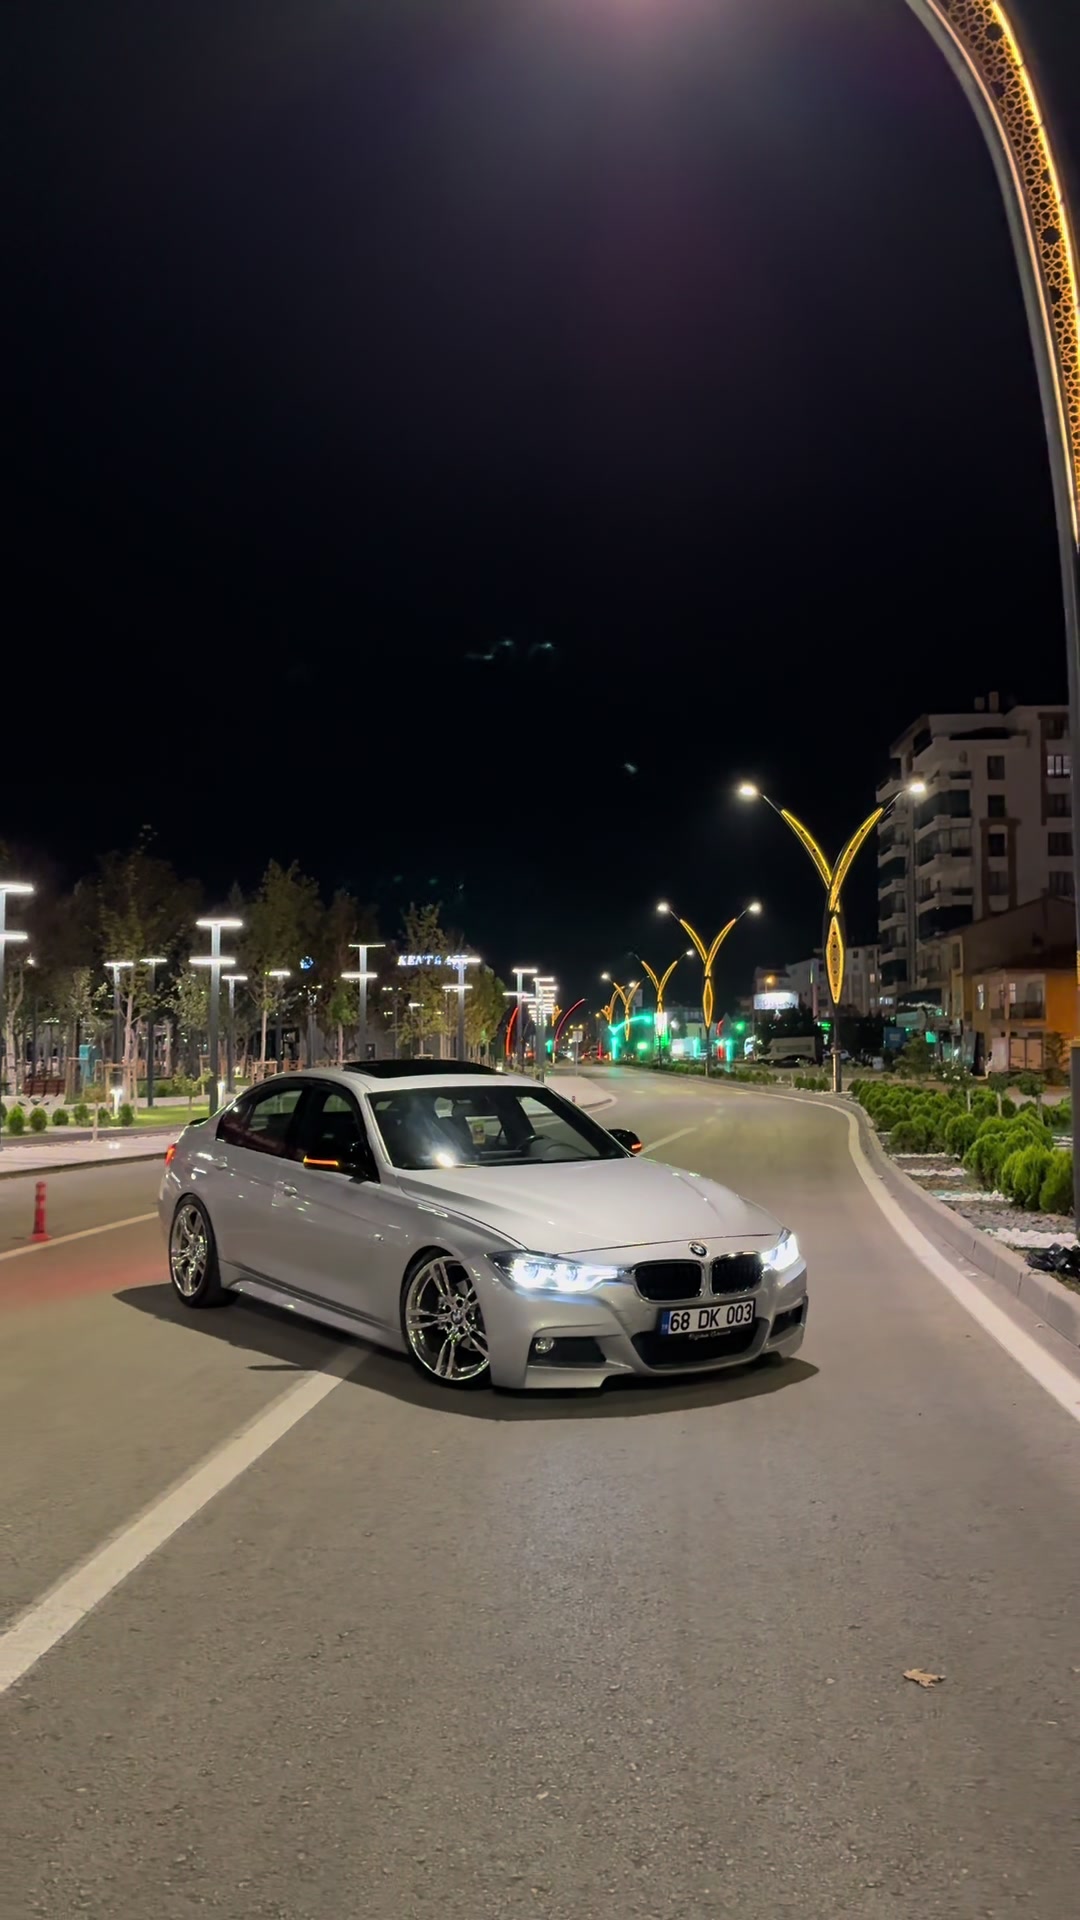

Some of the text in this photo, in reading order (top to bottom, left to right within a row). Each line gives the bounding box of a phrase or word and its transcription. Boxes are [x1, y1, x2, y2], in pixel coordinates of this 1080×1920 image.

[670, 1303, 752, 1332] 68 DK 003
